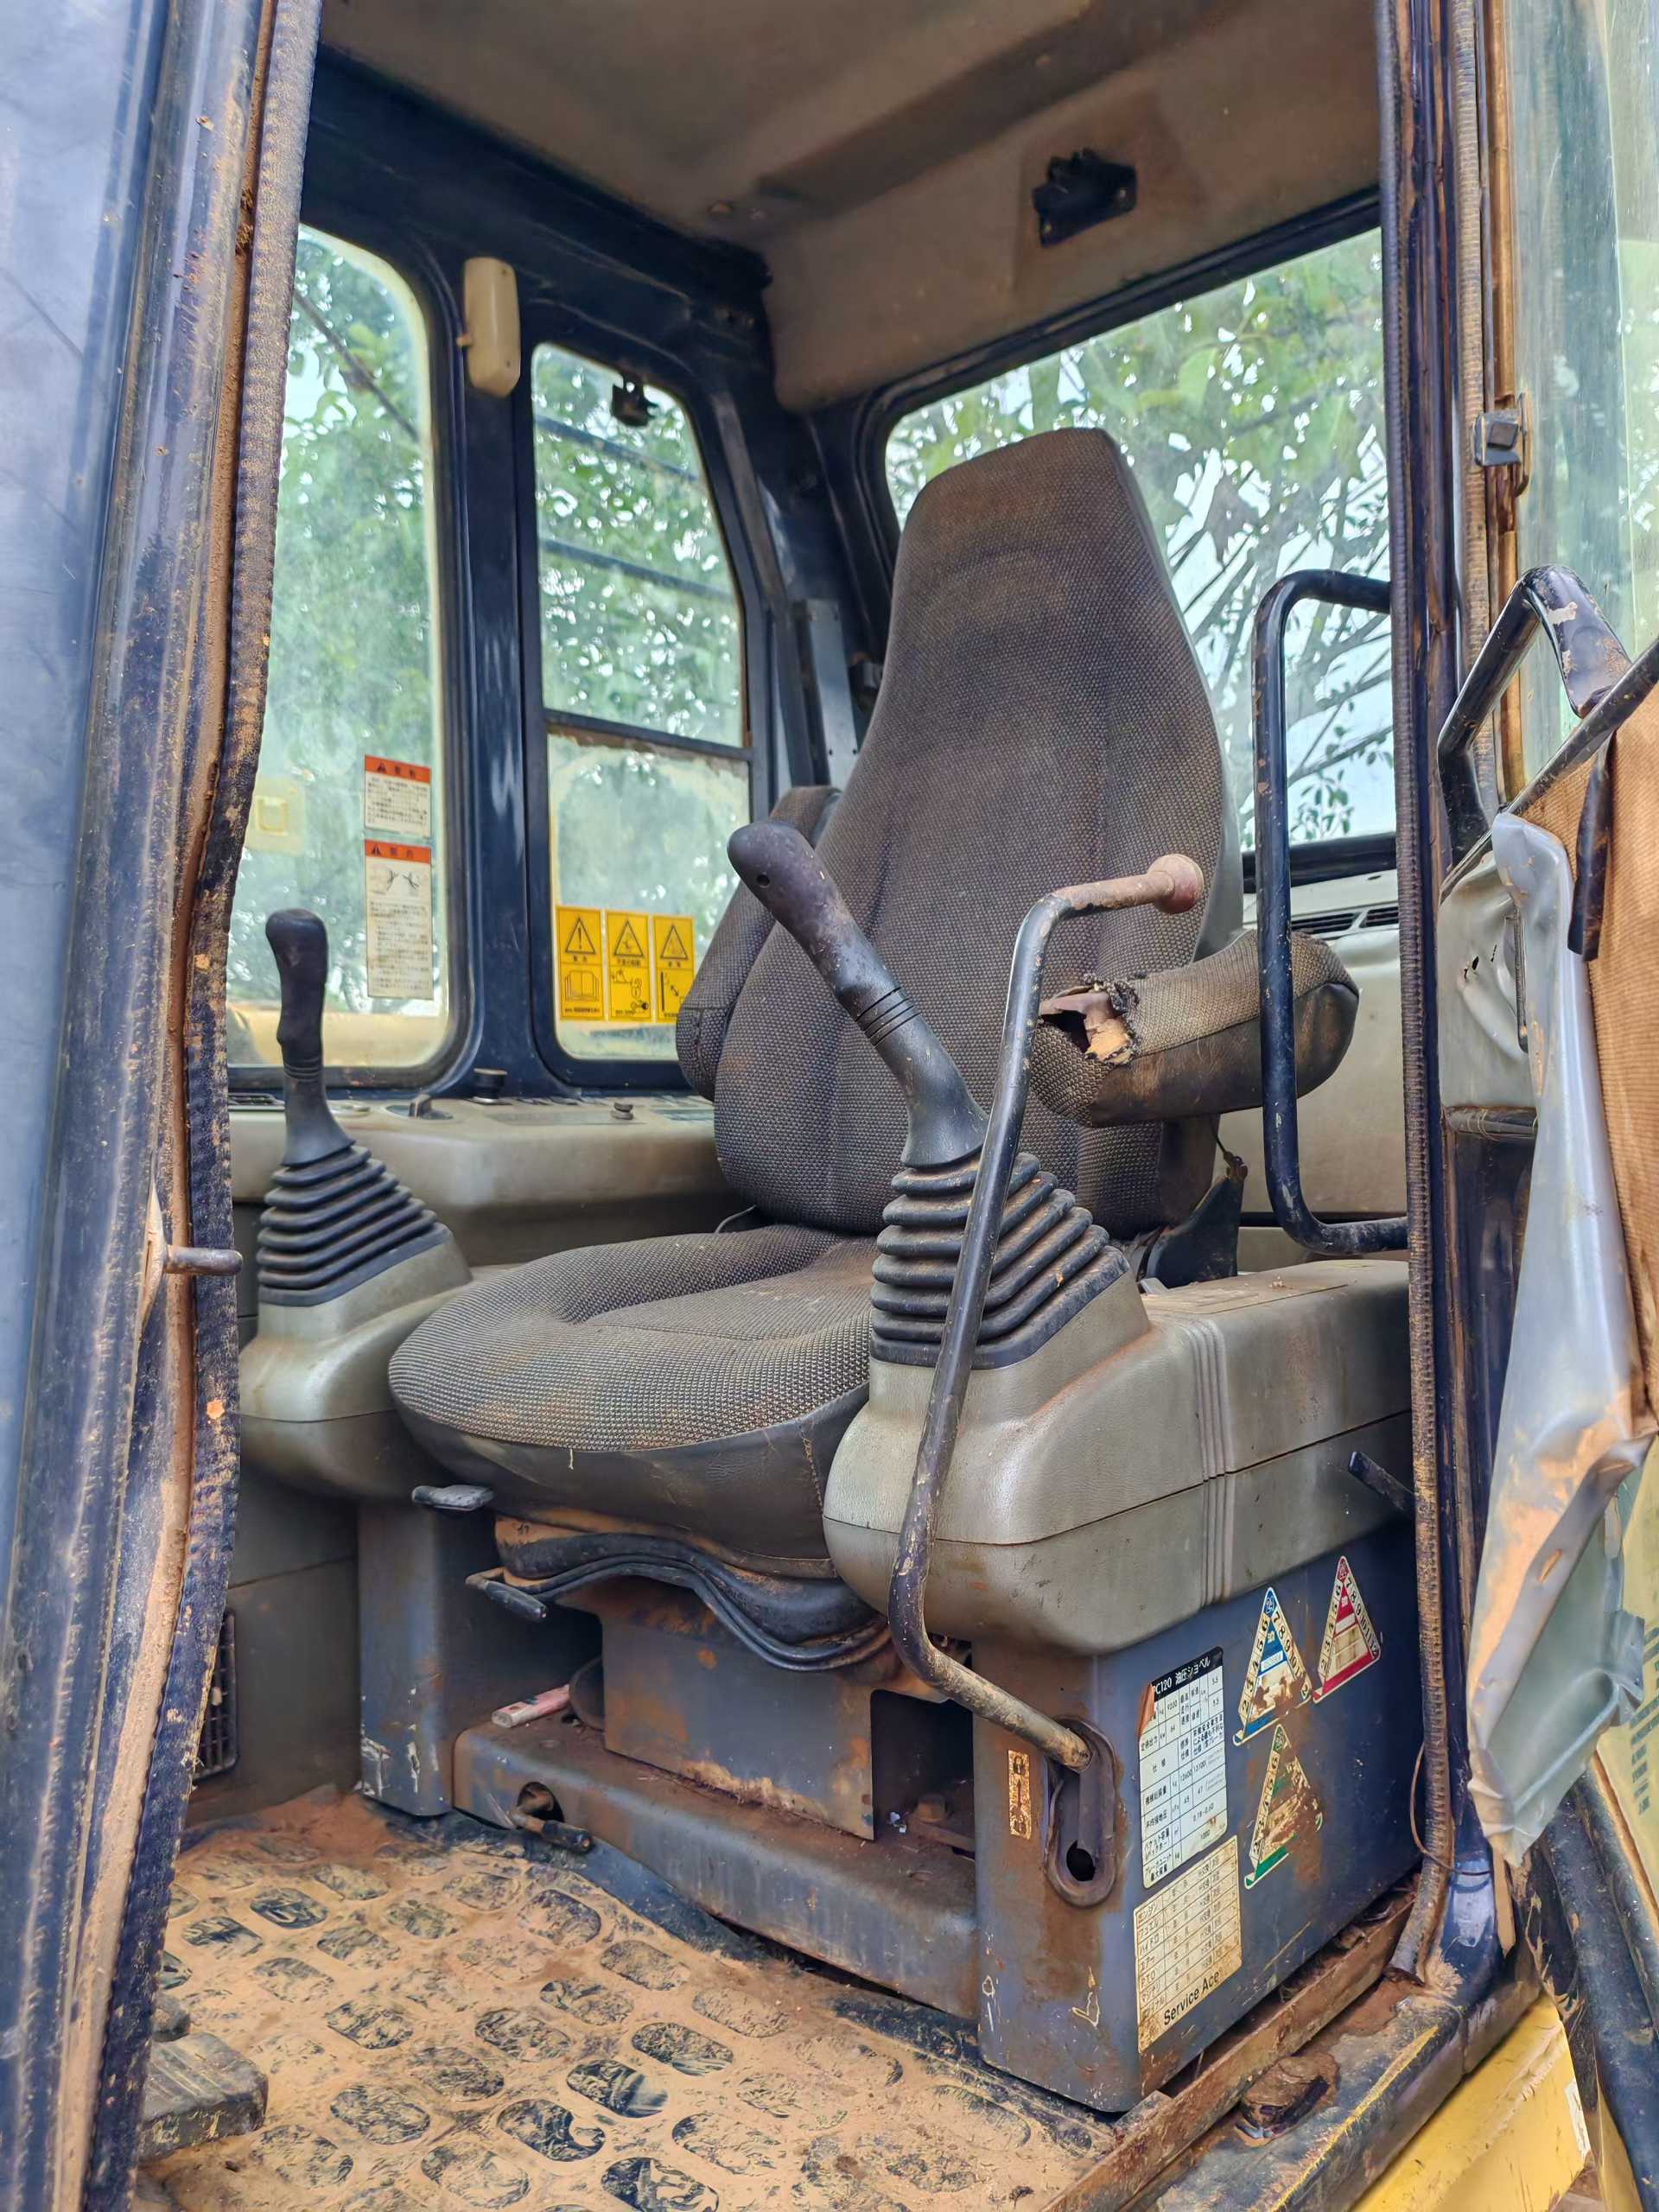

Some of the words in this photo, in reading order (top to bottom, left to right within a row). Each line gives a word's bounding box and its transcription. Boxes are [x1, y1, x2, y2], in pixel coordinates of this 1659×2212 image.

[1346, 1576, 1352, 1588] 7
[1274, 1611, 1281, 1624] 7
[1279, 1626, 1285, 1639] 8
[1256, 1639, 1263, 1652] 5
[1285, 1640, 1290, 1652] 9
[1252, 1660, 1259, 1672] 4
[1247, 1680, 1254, 1693] 3
[1242, 1700, 1249, 1713] 2
[1164, 1988, 1199, 2025] Service
[1201, 1971, 1219, 1994] Ace
